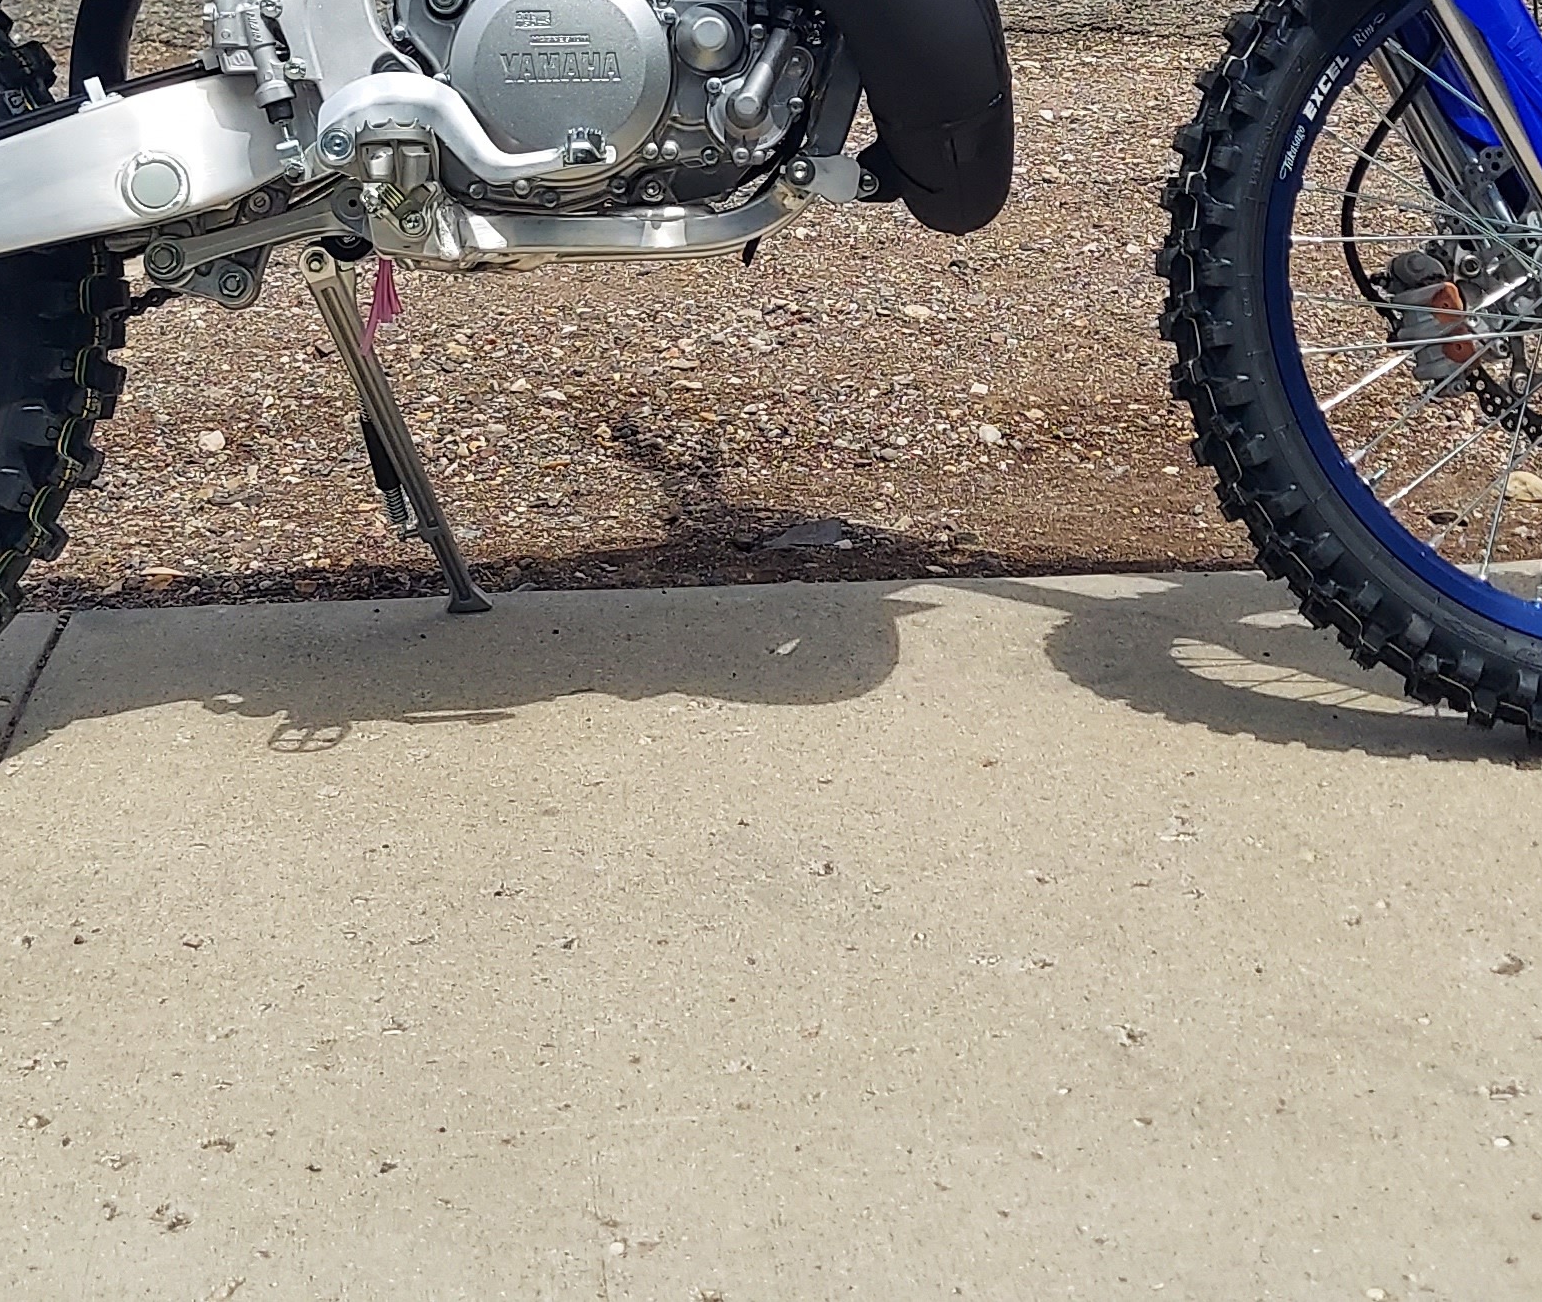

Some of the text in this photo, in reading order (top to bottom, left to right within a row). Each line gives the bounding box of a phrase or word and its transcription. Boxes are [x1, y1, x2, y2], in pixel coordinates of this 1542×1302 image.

[499, 51, 622, 84] YAMAHA
[1302, 55, 1350, 122] EXCEL
[1352, 12, 1386, 48] Rim
